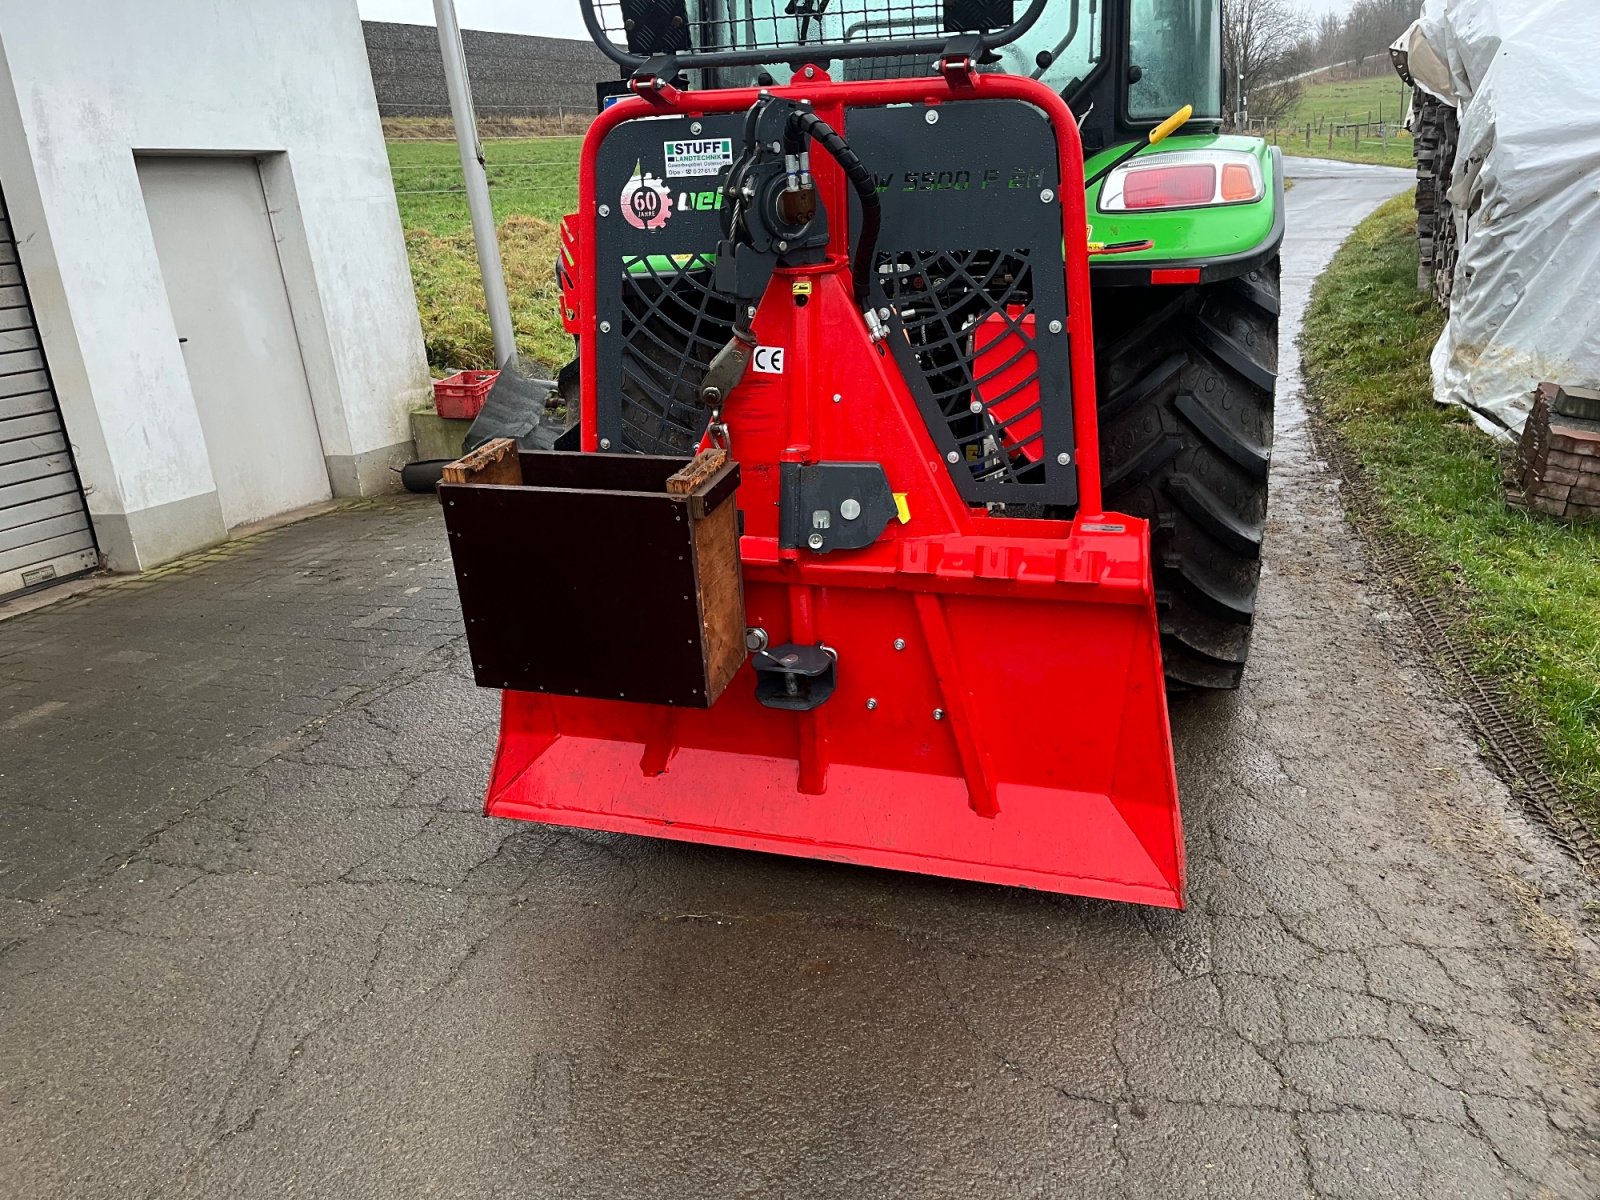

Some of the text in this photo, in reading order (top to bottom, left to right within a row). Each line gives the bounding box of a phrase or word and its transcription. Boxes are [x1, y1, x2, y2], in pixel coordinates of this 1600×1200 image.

[675, 141, 721, 155] STUFF
[675, 154, 722, 162] LANDTECHNIK
[903, 171, 970, 192] 5500
[634, 191, 657, 211] 60
[755, 348, 782, 371] CE
